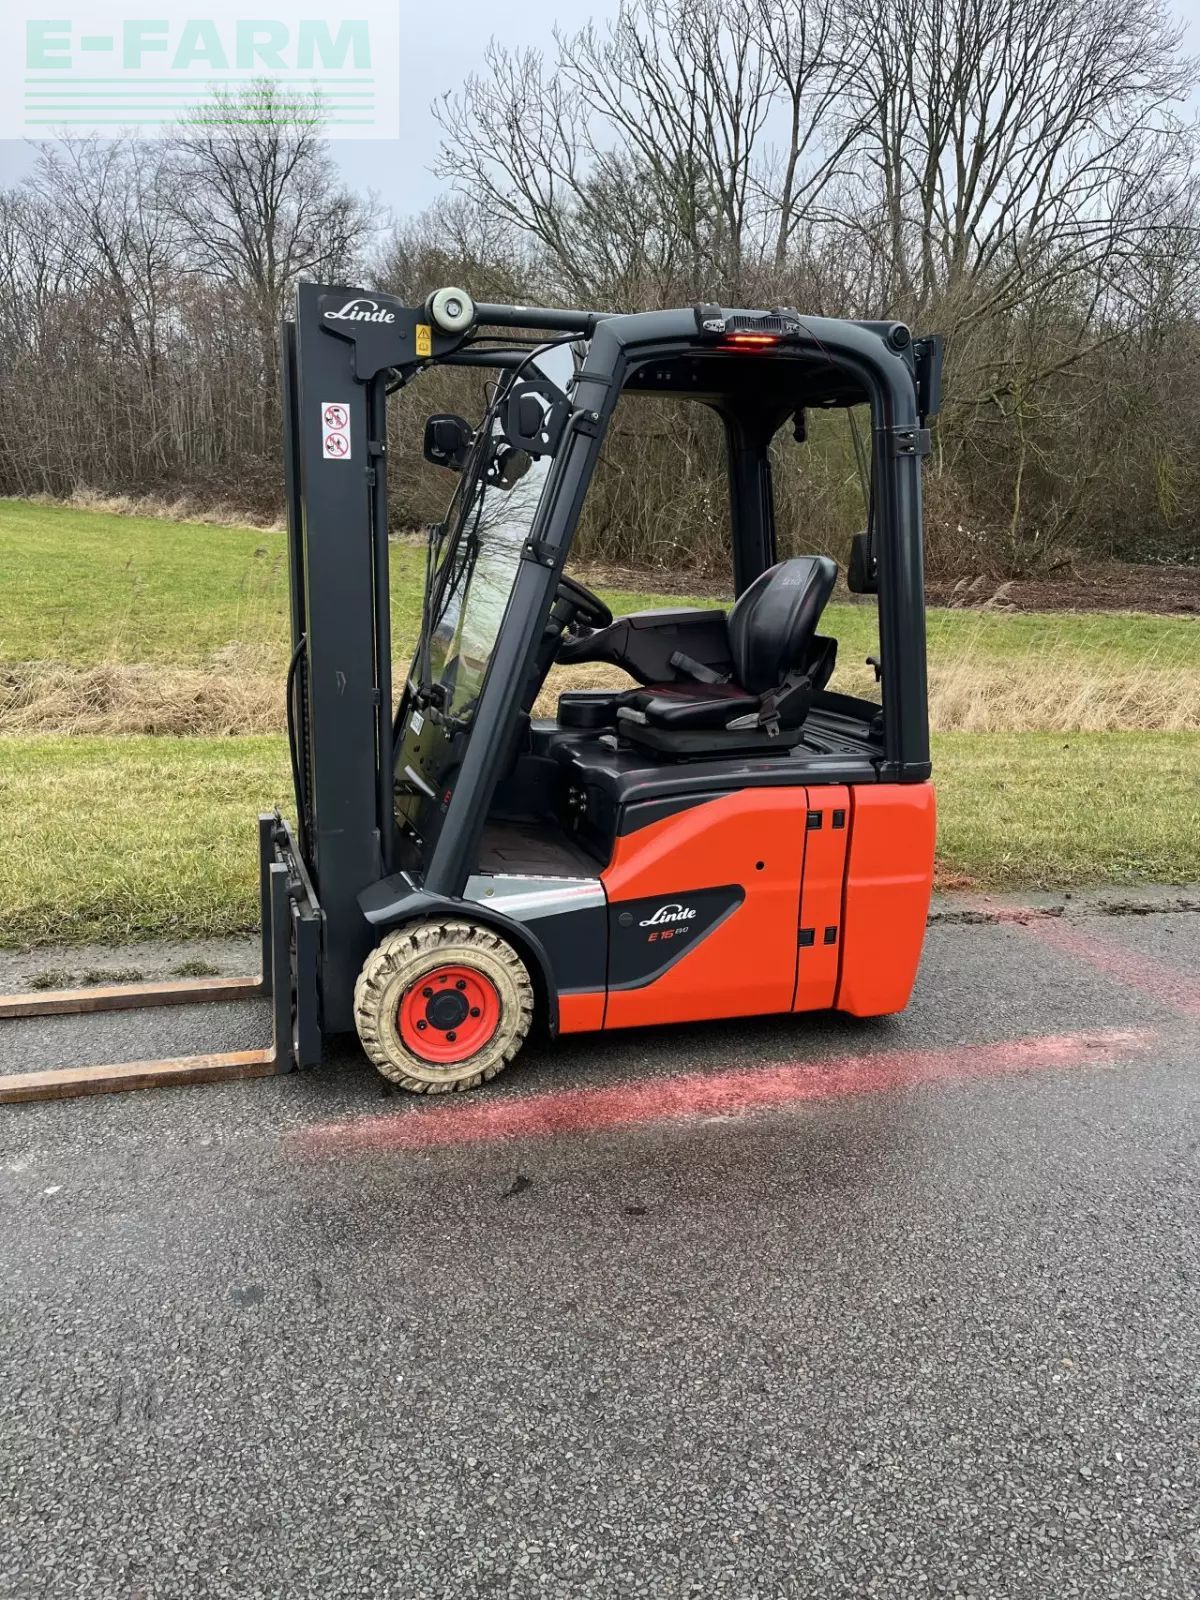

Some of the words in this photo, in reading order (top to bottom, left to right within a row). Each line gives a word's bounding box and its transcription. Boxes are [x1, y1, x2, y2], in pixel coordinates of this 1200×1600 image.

[324, 299, 395, 324] Linde
[639, 904, 696, 927] Linde
[648, 932, 658, 942] E
